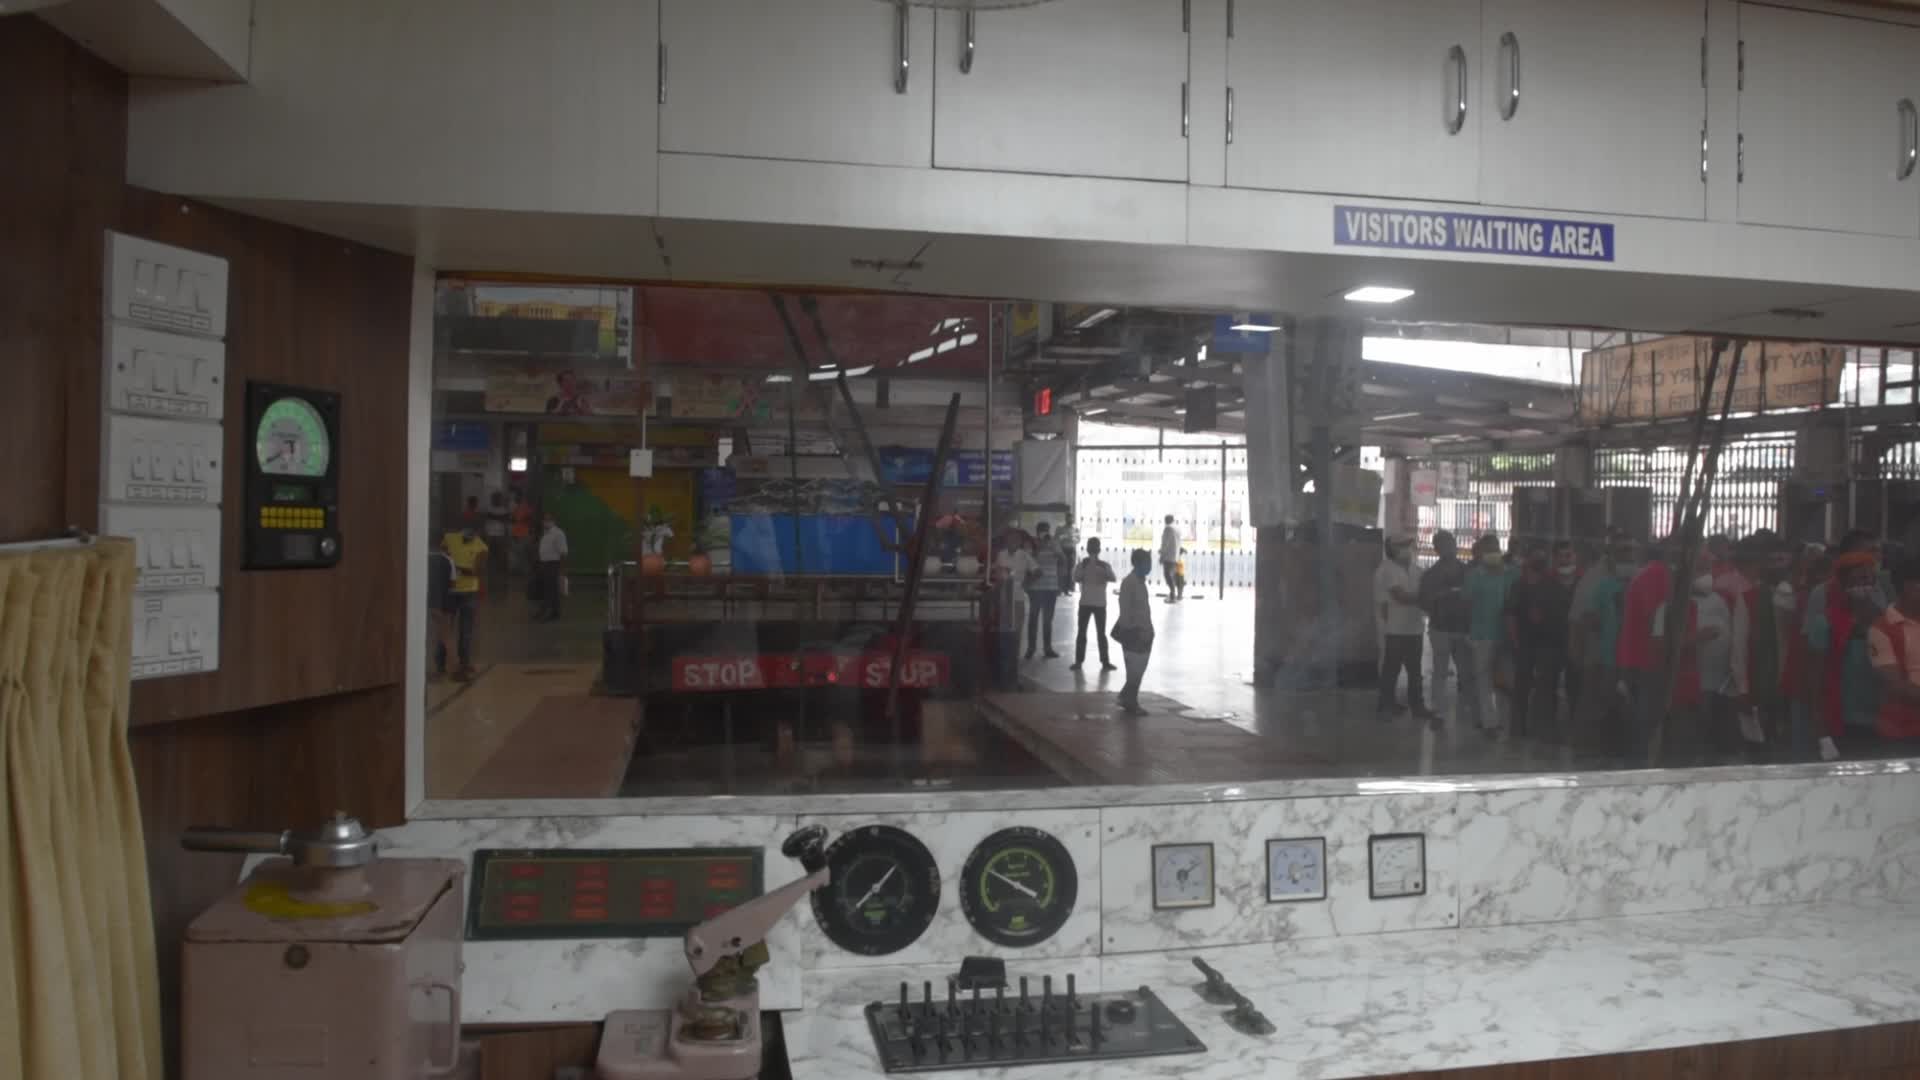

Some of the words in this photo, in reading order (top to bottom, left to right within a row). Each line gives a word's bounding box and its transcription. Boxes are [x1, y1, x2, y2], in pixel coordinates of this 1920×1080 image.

[1345, 210, 1448, 246] VISITORS
[1453, 217, 1544, 252] WAITING
[1549, 224, 1604, 256] AREA
[684, 661, 756, 687] STOP
